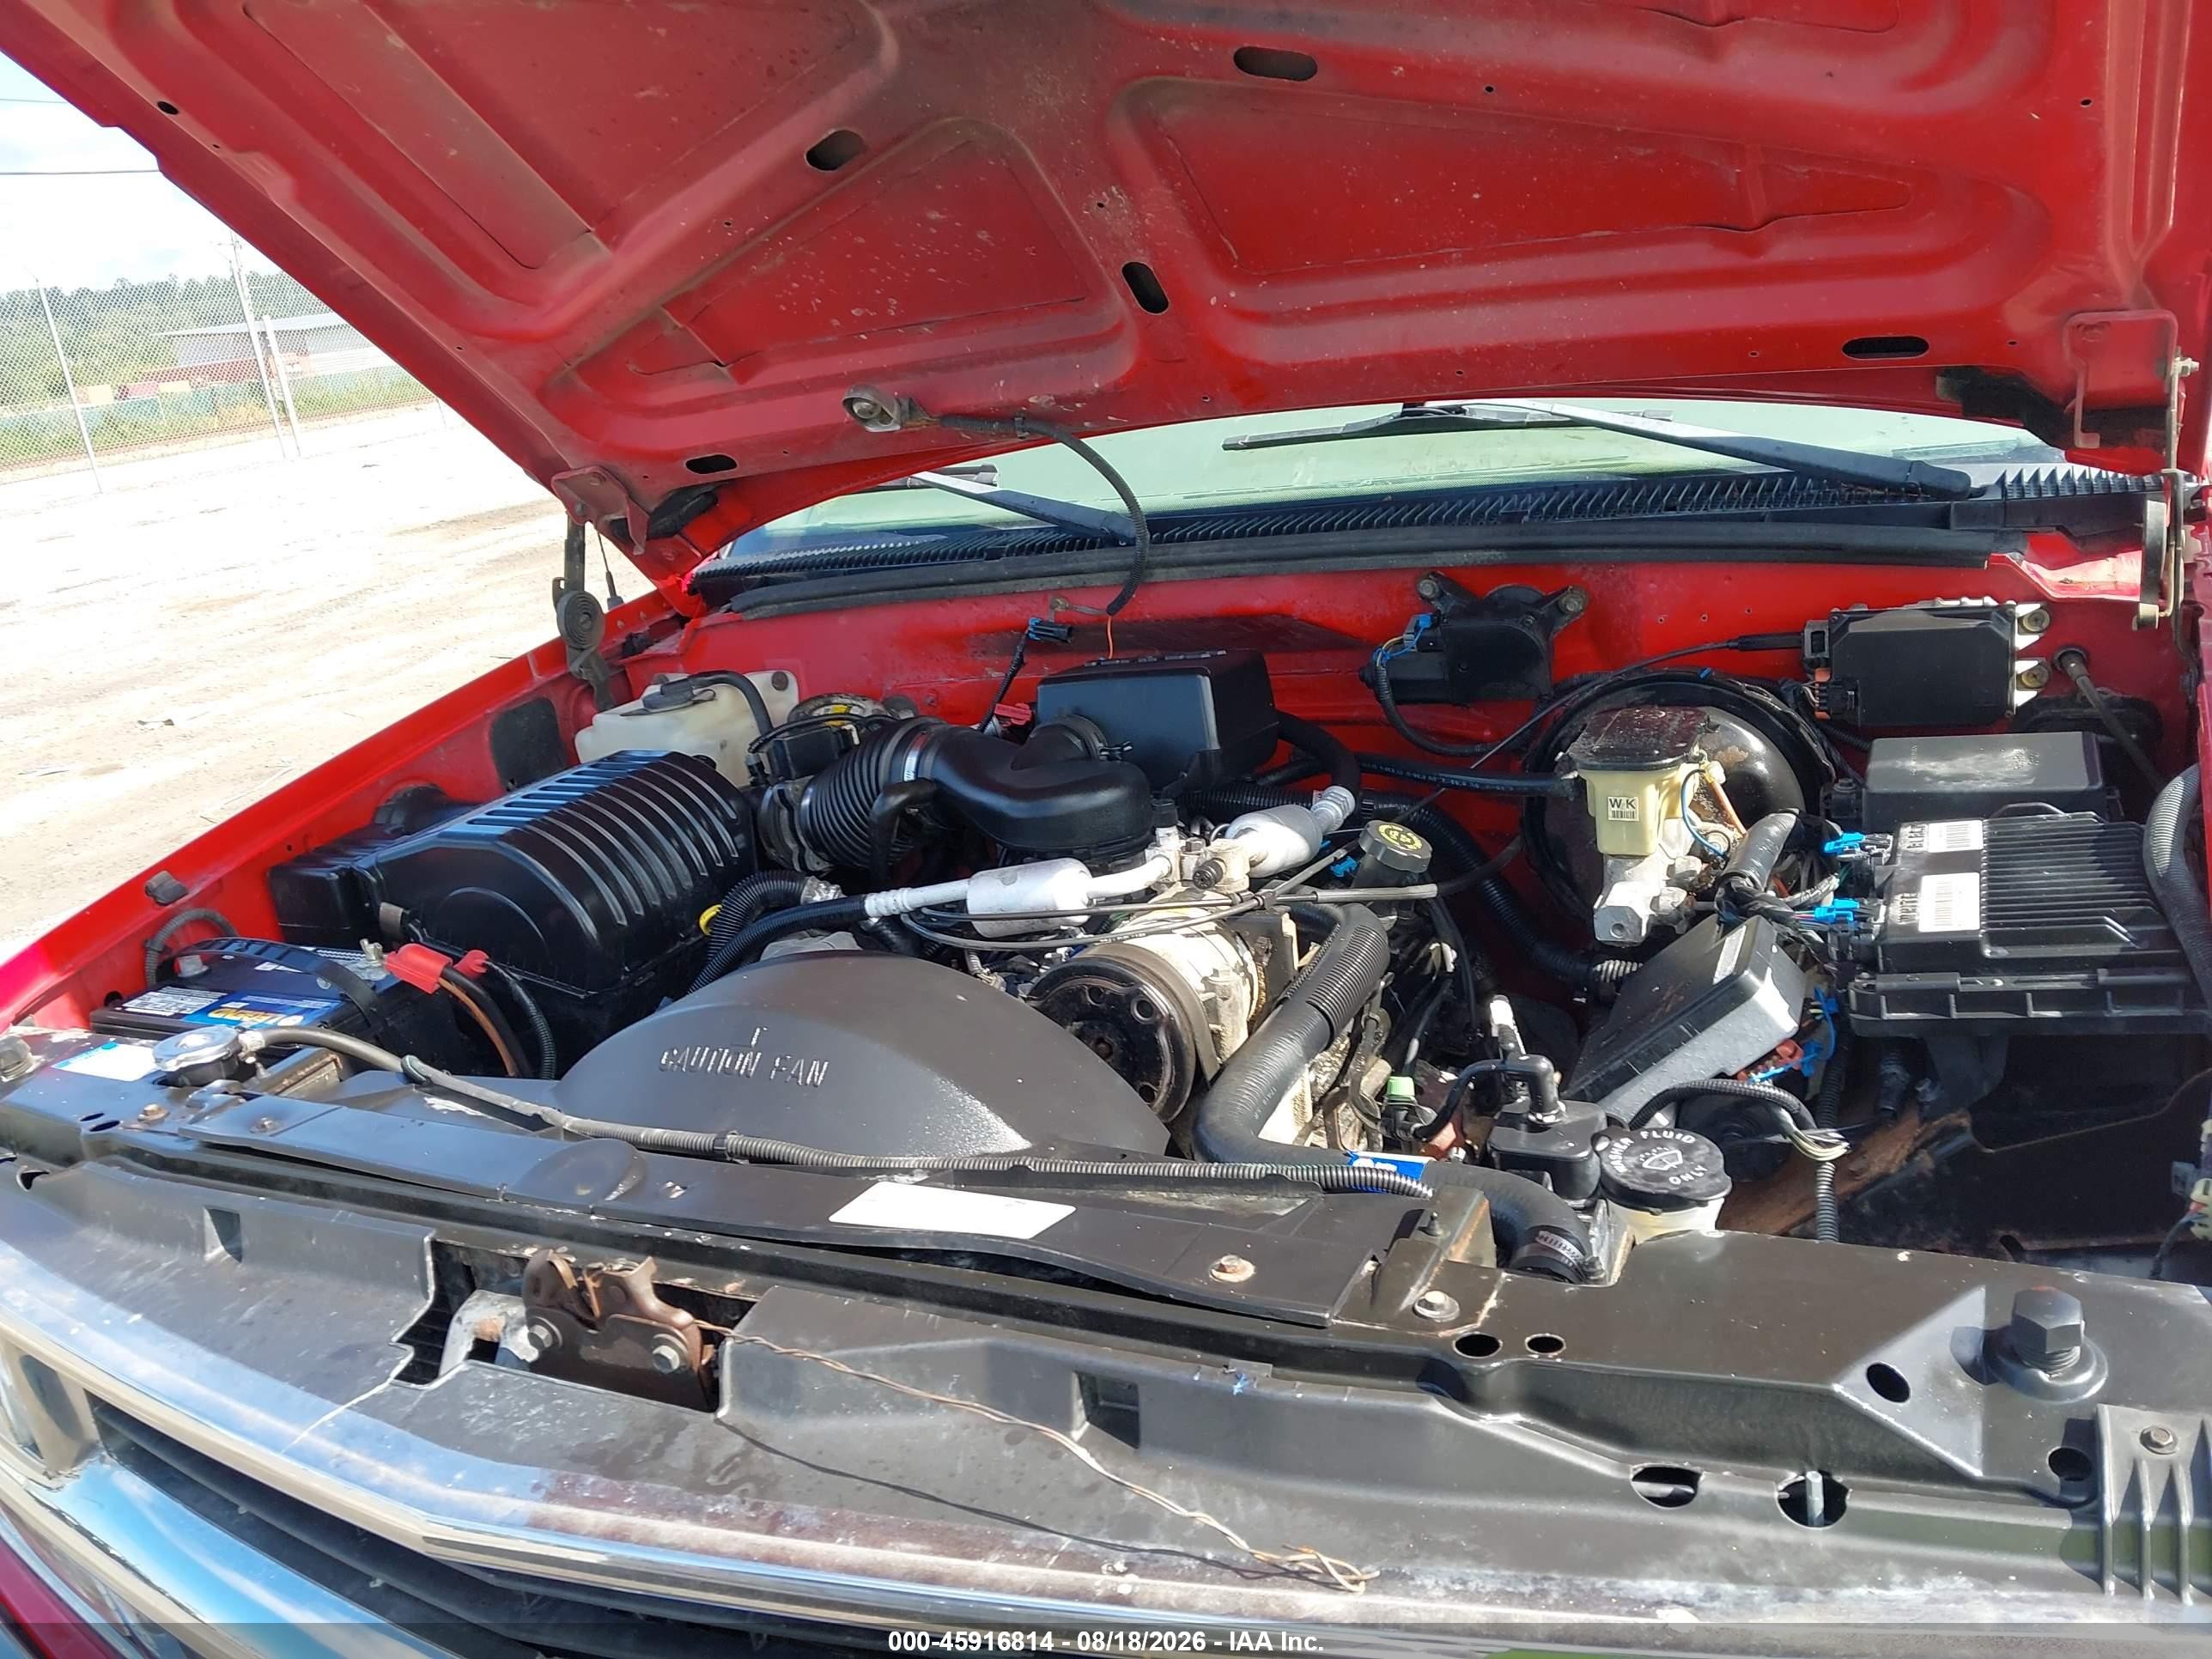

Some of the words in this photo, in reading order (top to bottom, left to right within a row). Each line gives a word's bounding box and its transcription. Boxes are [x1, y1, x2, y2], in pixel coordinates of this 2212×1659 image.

[659, 1046, 763, 1079] CAUTION
[769, 1054, 830, 1088] FAN
[1608, 1137, 1635, 1174] WASHER
[1639, 1130, 1697, 1145] FLUID
[1668, 1164, 1709, 1186] ONLY
